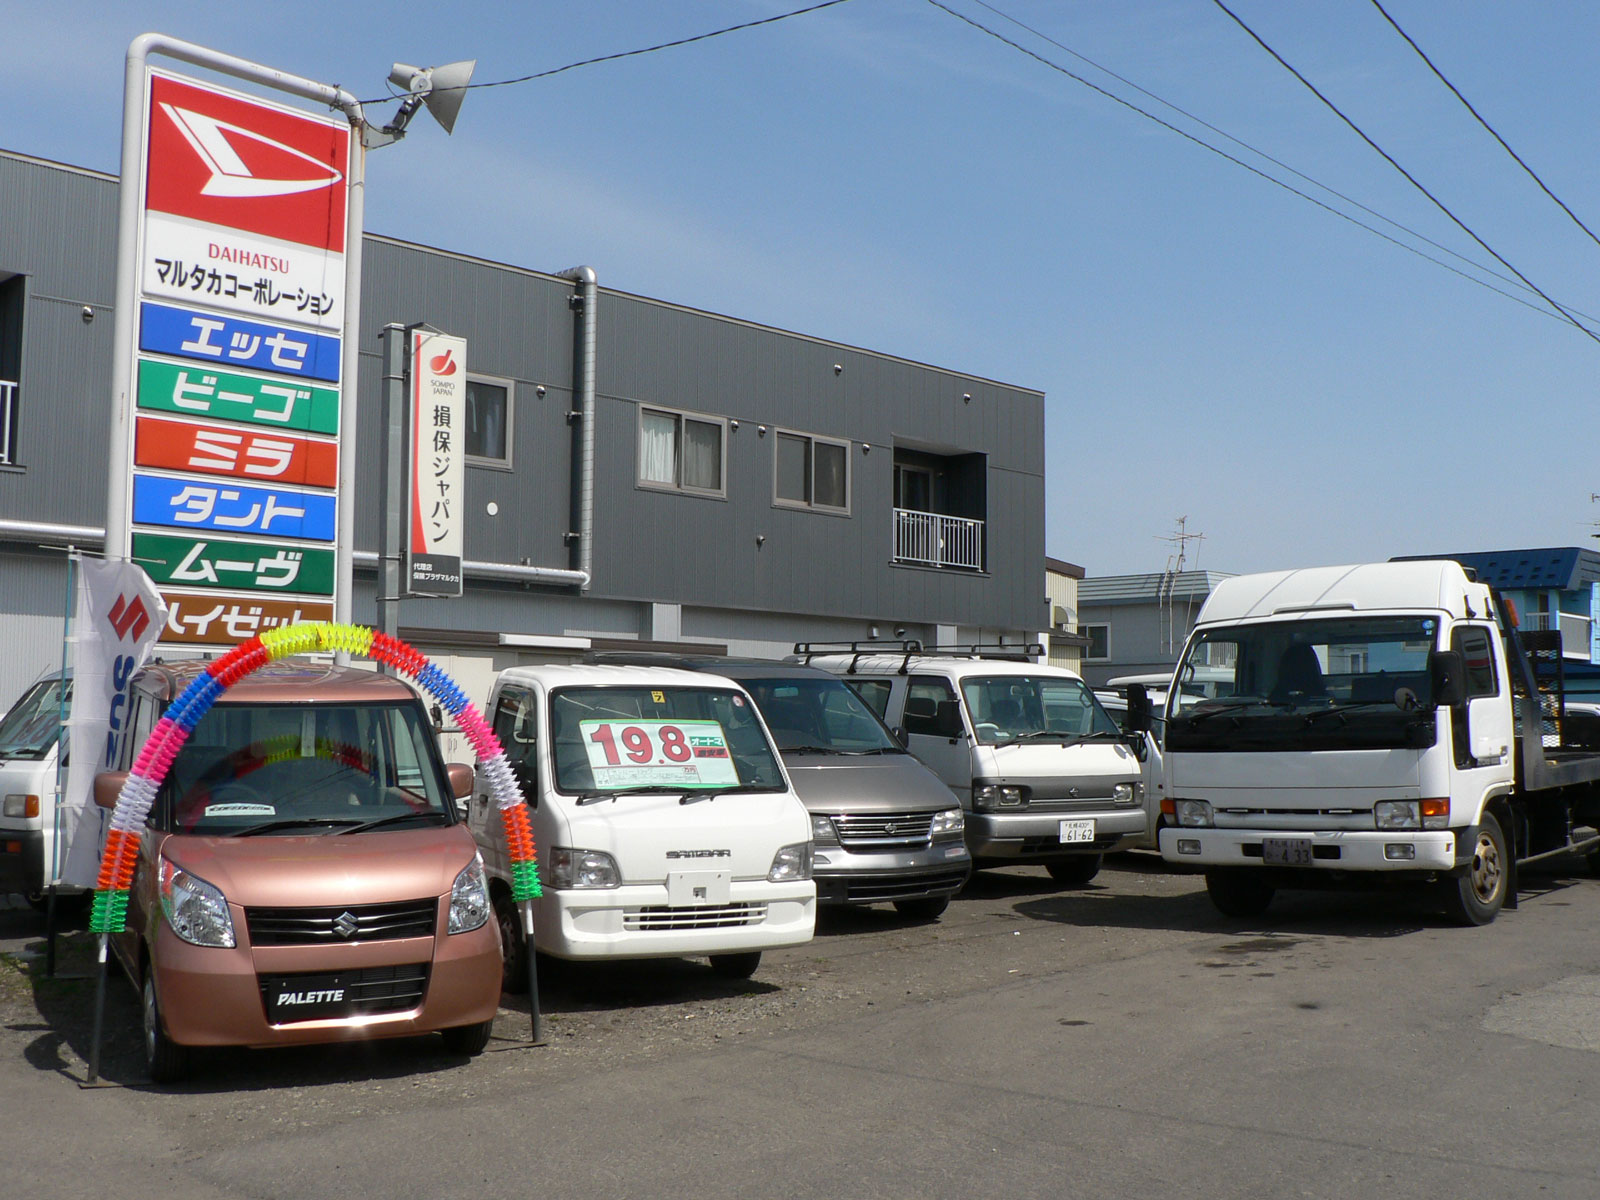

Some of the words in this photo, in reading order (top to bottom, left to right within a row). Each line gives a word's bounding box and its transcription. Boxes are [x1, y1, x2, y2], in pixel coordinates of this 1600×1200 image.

[208, 243, 289, 274] DAIHATSU
[155, 258, 334, 316] マルタカコーポレーション
[181, 317, 308, 369] エッセ
[173, 372, 311, 422] ビーゴ
[430, 379, 455, 390] SOMPO
[433, 387, 453, 397] JAPAN
[188, 430, 295, 476] ミラ
[431, 404, 451, 543] 損保ジャパン
[170, 486, 305, 530] タント
[169, 542, 303, 587] ムーヴ
[590, 724, 692, 765] 19.8
[691, 737, 723, 746] オートマ
[665, 849, 732, 859] SAMBAR
[1067, 829, 1093, 841] 61-62
[277, 989, 345, 1006] PALETTE
